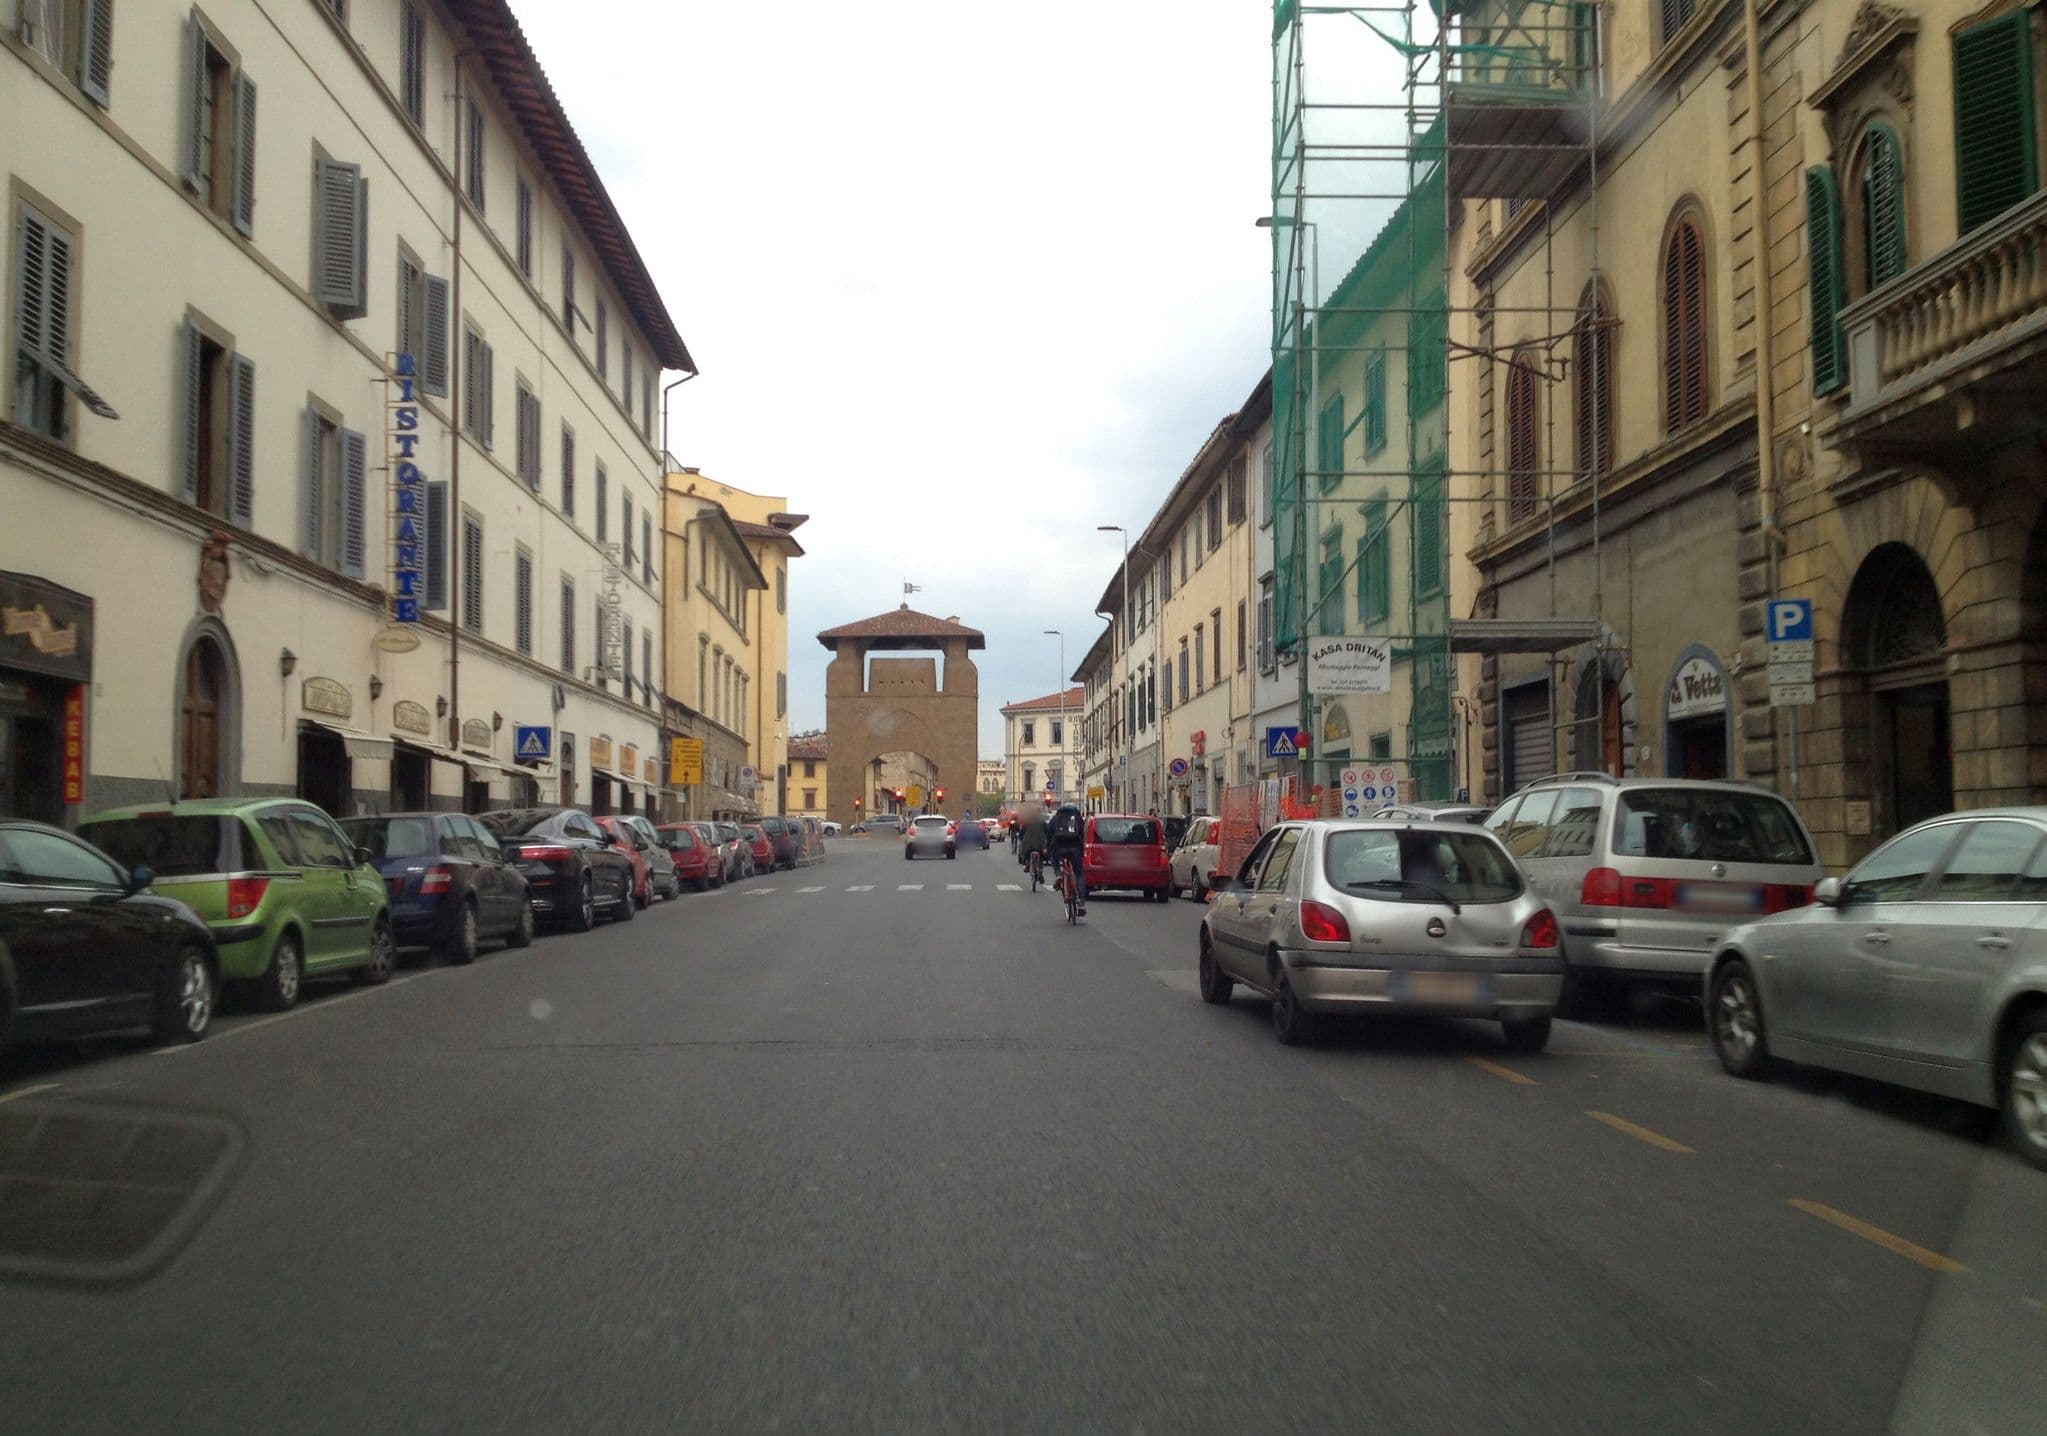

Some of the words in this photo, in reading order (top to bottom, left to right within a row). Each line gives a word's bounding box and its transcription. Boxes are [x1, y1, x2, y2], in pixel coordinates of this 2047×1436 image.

[396, 352, 419, 622] RISTORANTE
[1774, 604, 1804, 638] P
[1312, 643, 1343, 662] KASA
[1346, 643, 1386, 662] DRITAN
[1684, 672, 1722, 701] Vetta
[67, 701, 80, 798] KEBAB
